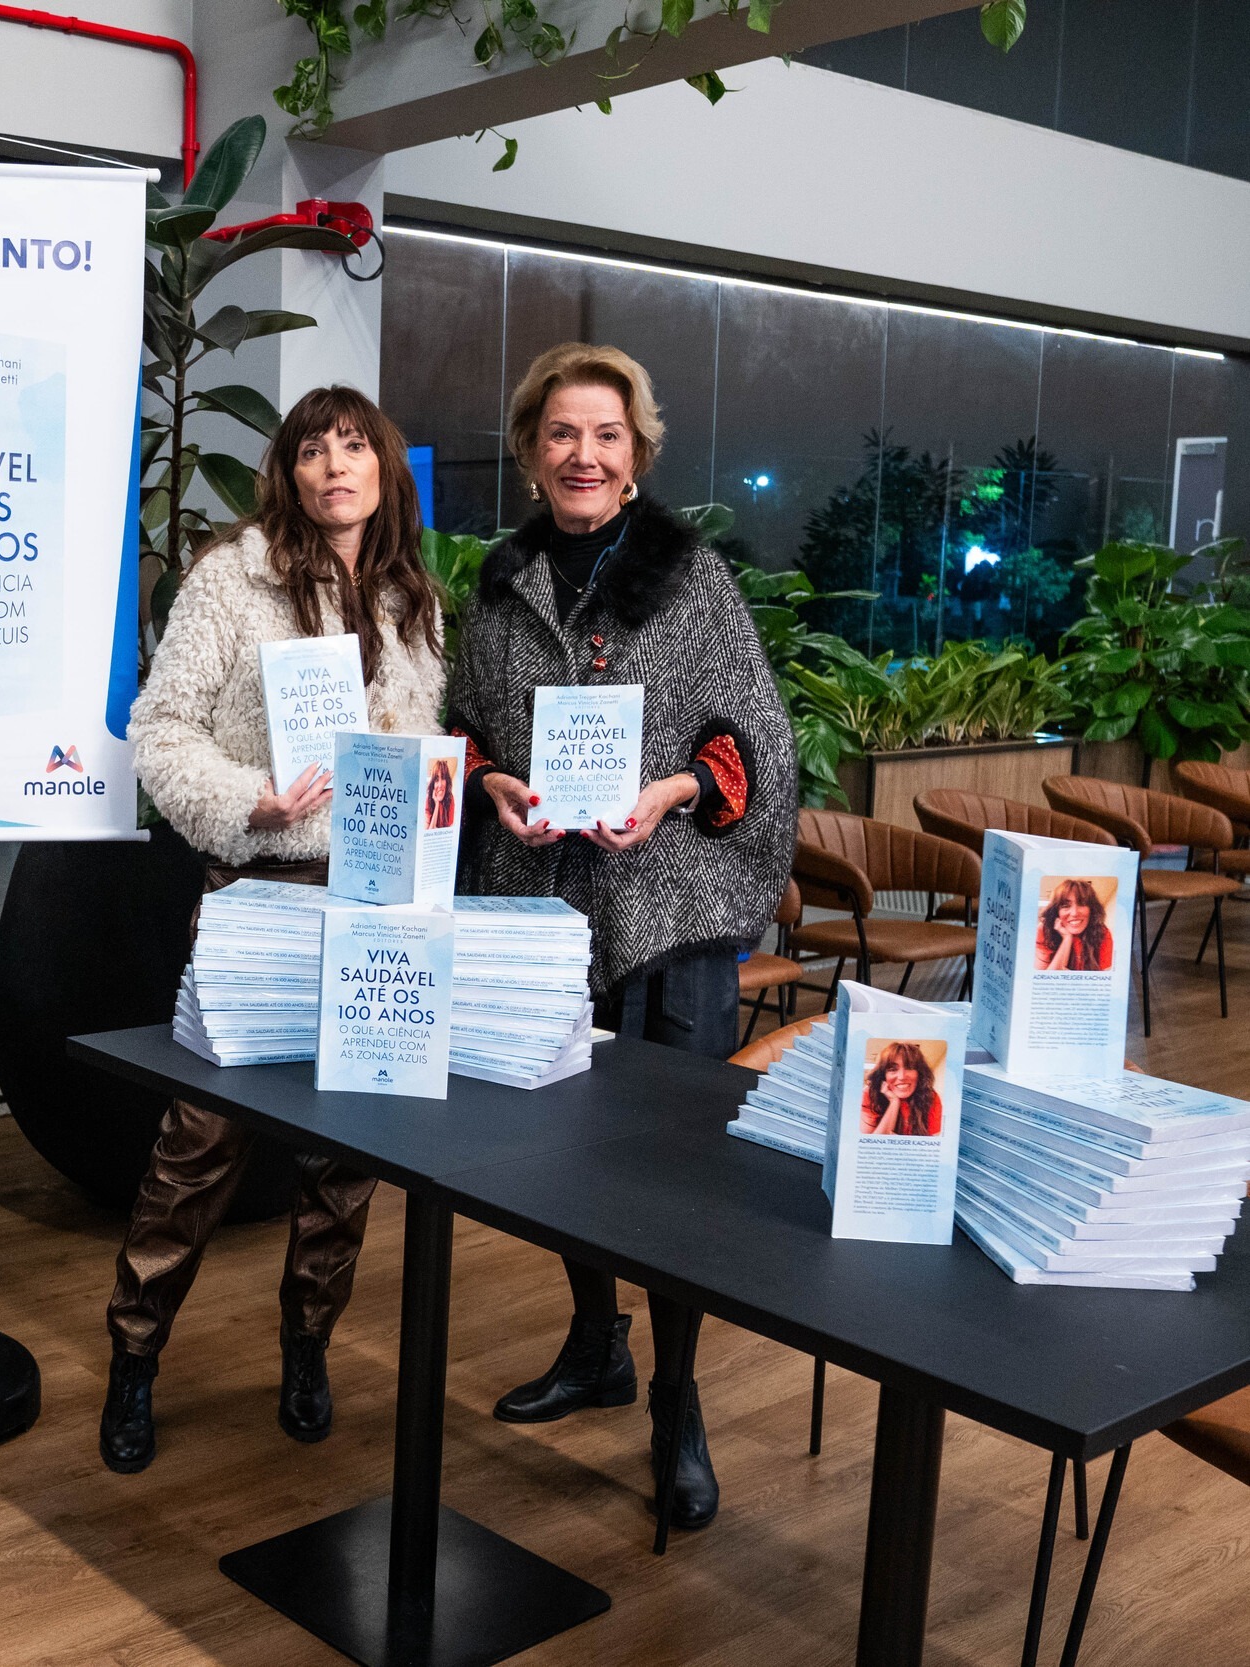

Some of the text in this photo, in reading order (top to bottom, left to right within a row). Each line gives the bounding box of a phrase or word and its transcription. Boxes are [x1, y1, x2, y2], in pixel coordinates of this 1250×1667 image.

[297, 668, 331, 680] VIVA
[280, 681, 353, 700] SAUDÁVEL
[294, 697, 343, 714] ATÉ OS
[283, 712, 357, 731] 100 ANOS
[570, 714, 606, 725] VIVA
[548, 726, 627, 740] SAUDÁVEL
[559, 741, 614, 755] ATÉ OS
[545, 758, 627, 770] 100 ANOS
[364, 768, 392, 784] VIVA
[587, 773, 623, 782] CIÊNCIA
[24, 776, 106, 796] manole
[345, 783, 408, 803] SAUDÁVEL
[354, 801, 398, 820] ATÉ OS
[343, 818, 366, 833] 100
[370, 822, 407, 839] ANOS
[344, 836, 350, 844] O
[352, 837, 367, 847] QUE
[376, 840, 404, 852] CIÊNCIA
[345, 848, 401, 864] APRENDEU COM
[344, 859, 402, 876] AS ZONAS AZUIS
[367, 949, 410, 966] VIVA
[340, 967, 435, 987] SAUDÁVEL
[354, 985, 420, 1005] ATÉ OS
[338, 1005, 435, 1025] 100 ANOS
[339, 1025, 431, 1039] O QUE A CIÊNCIA
[343, 1038, 426, 1051] APRENDEU COM
[356, 1051, 394, 1062] ZONAS
[397, 1053, 427, 1064] AZUIS
